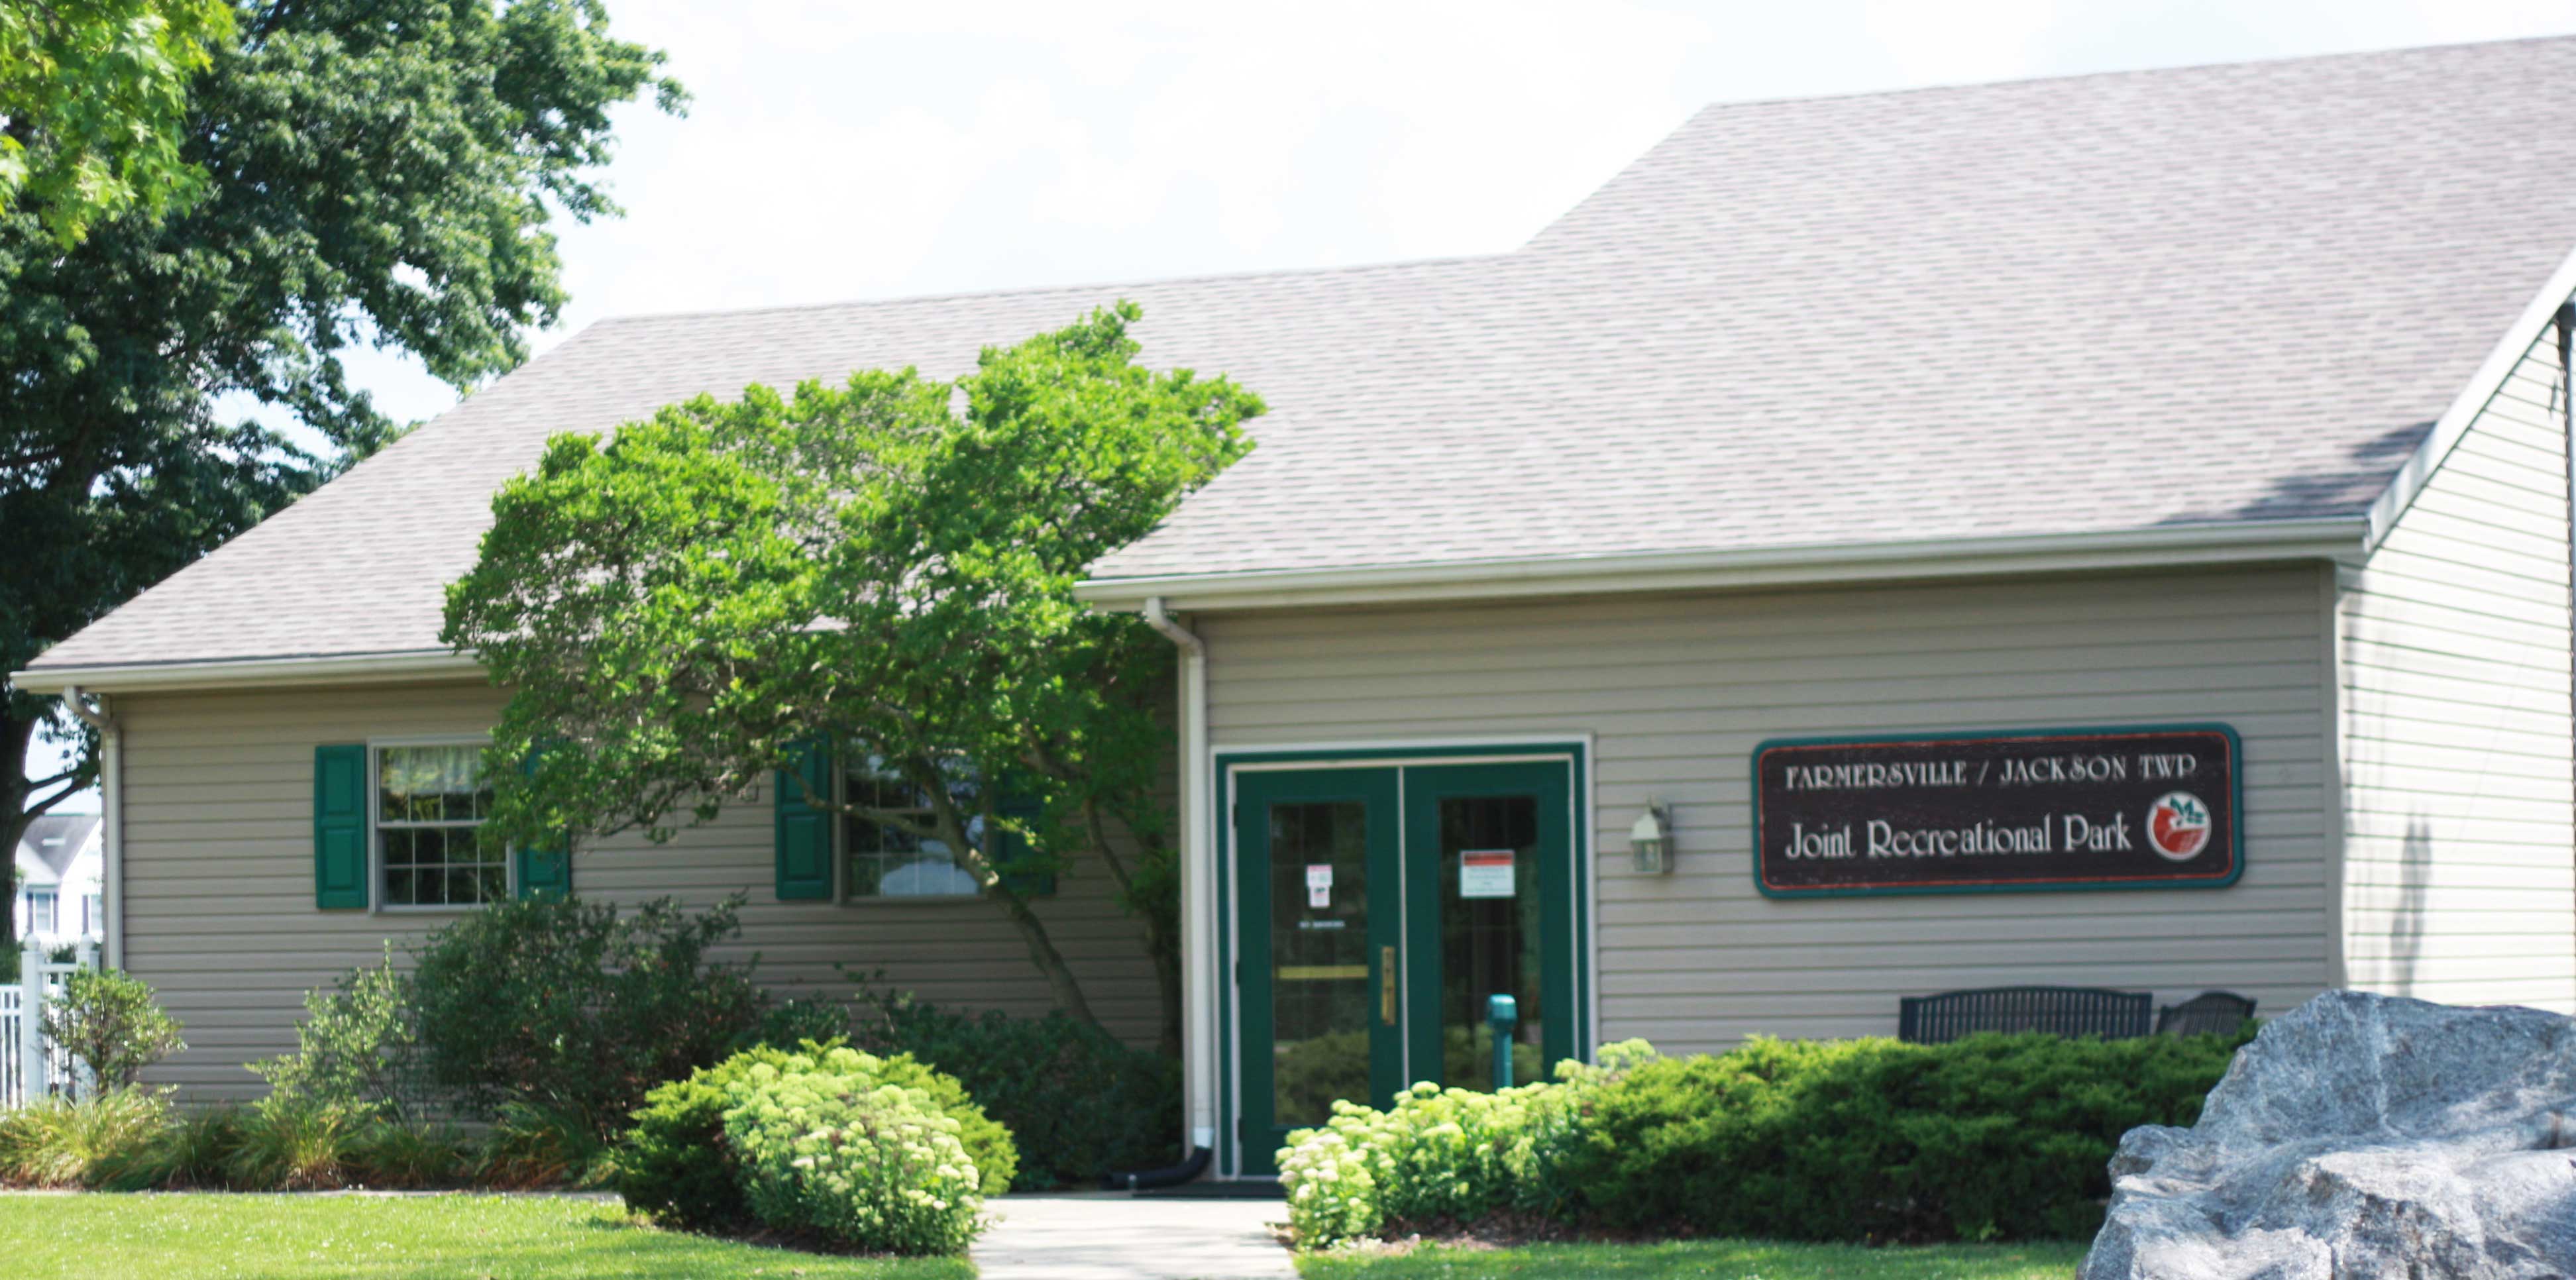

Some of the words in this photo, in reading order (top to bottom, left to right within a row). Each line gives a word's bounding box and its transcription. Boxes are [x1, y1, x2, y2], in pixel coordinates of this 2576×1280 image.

[1786, 761, 1967, 789] FARMERSVILLE
[1978, 761, 1990, 786] /
[1999, 755, 2127, 784] JACKSON
[2138, 753, 2197, 780] TWP
[1785, 822, 1856, 859] Joint
[1866, 812, 2051, 858] Recreational
[2063, 811, 2133, 852] Park
